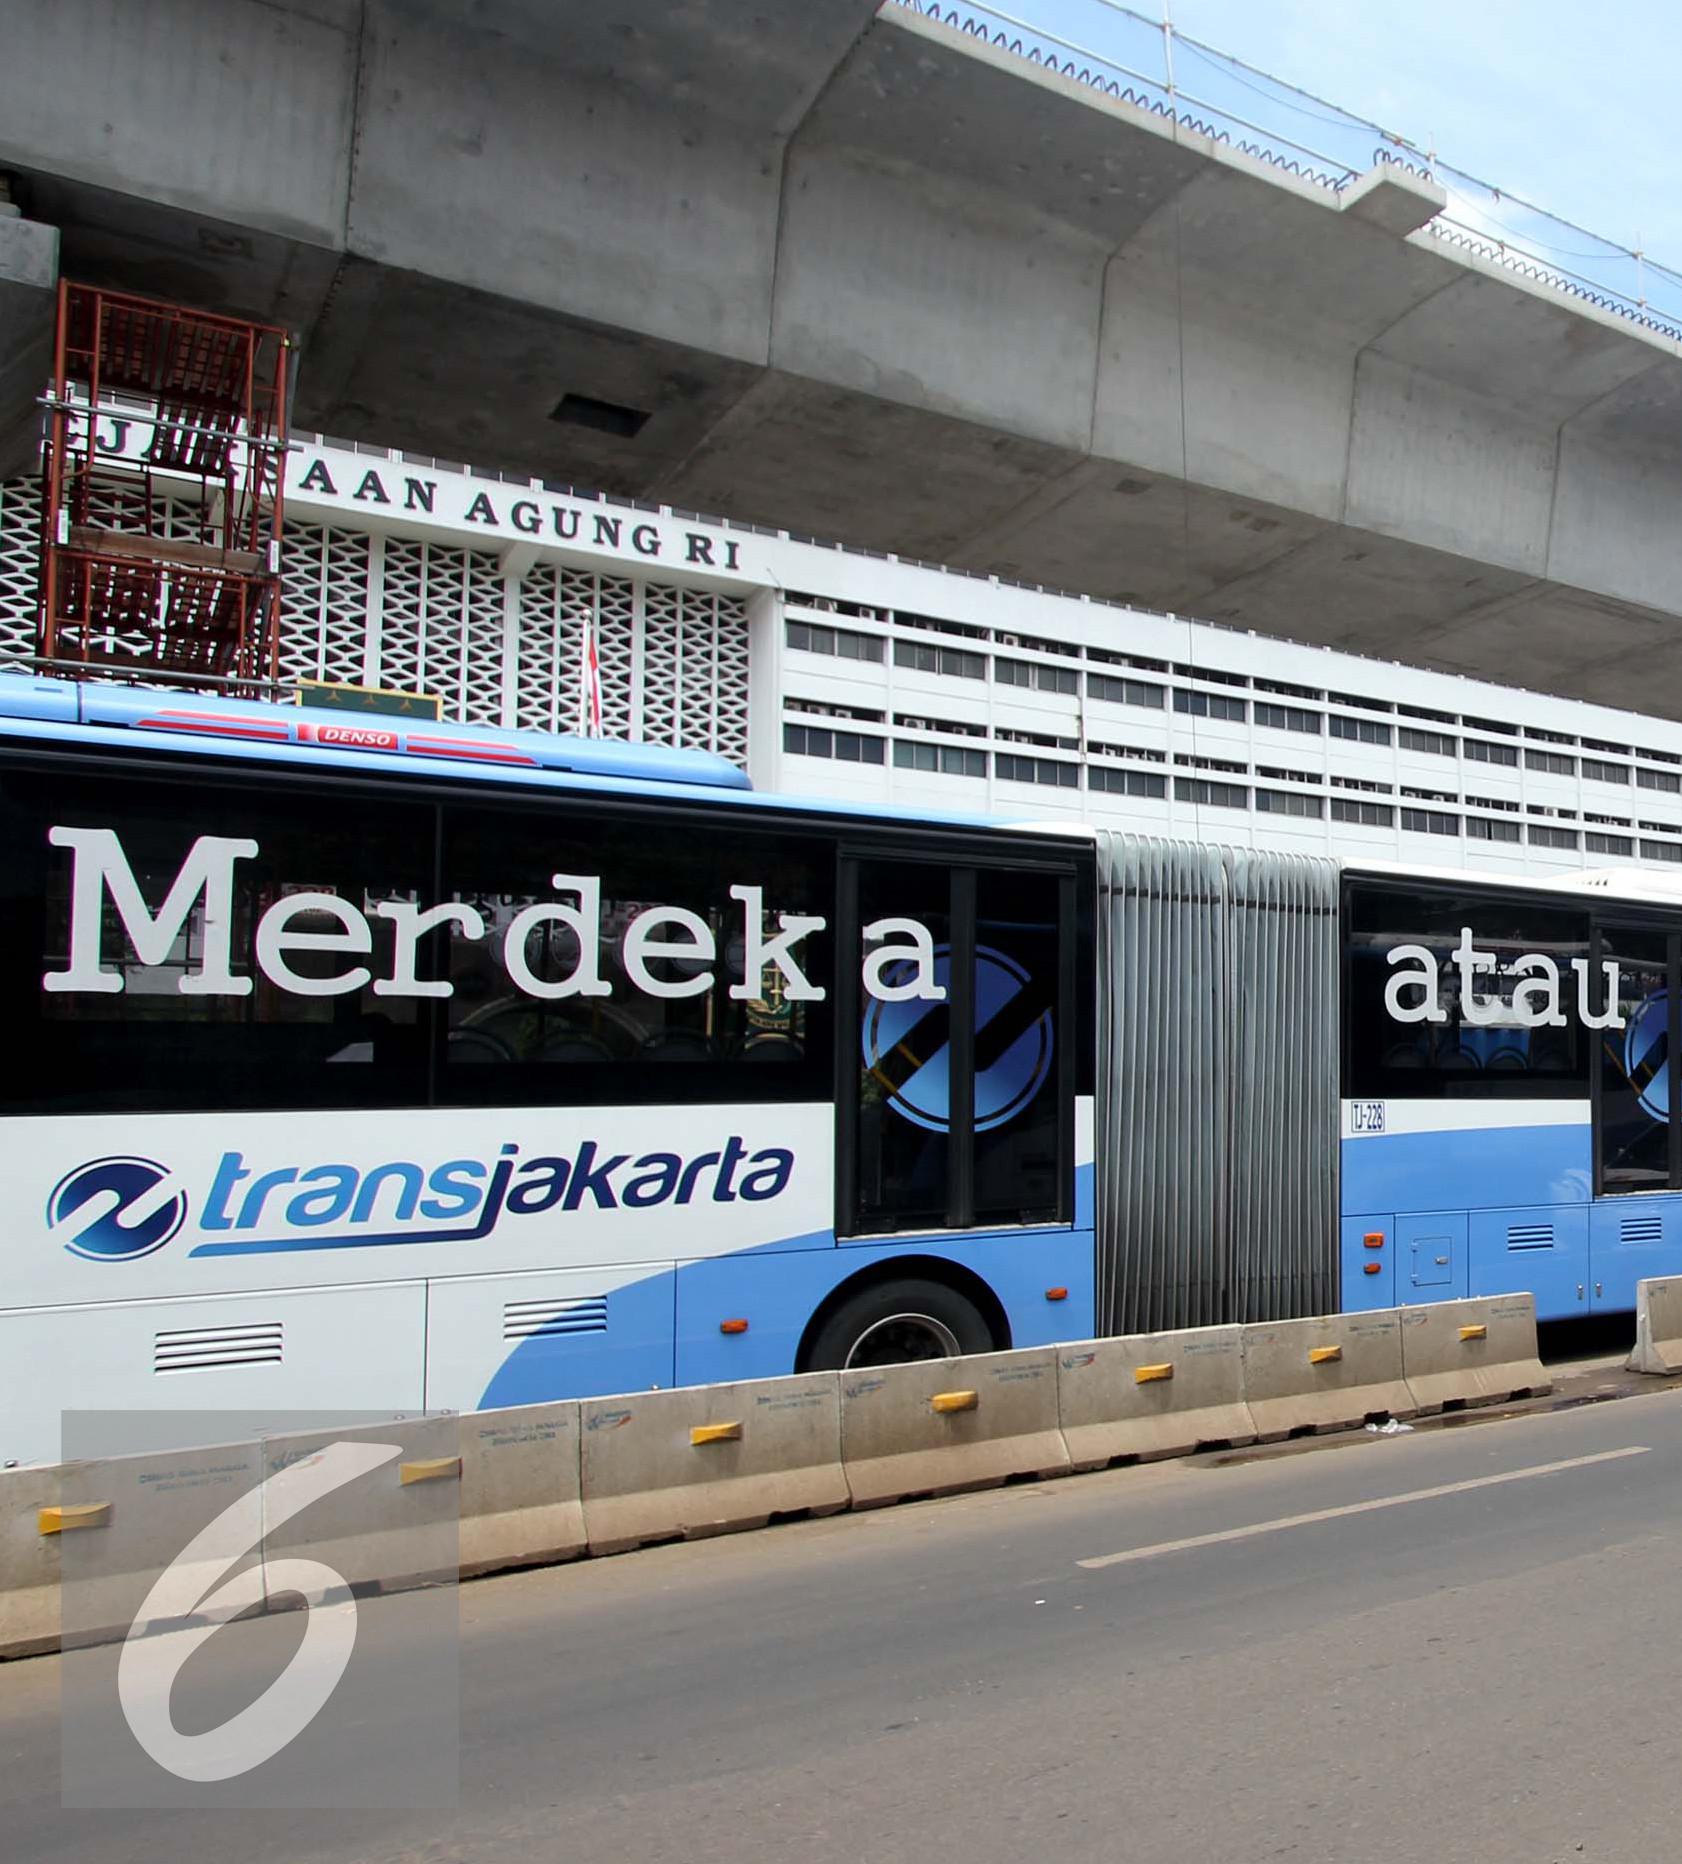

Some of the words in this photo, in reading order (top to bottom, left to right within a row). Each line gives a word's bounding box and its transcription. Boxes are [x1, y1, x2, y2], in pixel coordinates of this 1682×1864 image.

[465, 491, 662, 557] AGUNG
[685, 532, 740, 570] RI
[324, 727, 391, 746] DENSO
[43, 826, 948, 1001] Merdeka
[1384, 926, 1627, 1030] atau
[1353, 1103, 1383, 1130] TJ-228
[190, 1136, 795, 1257] transjakarta
